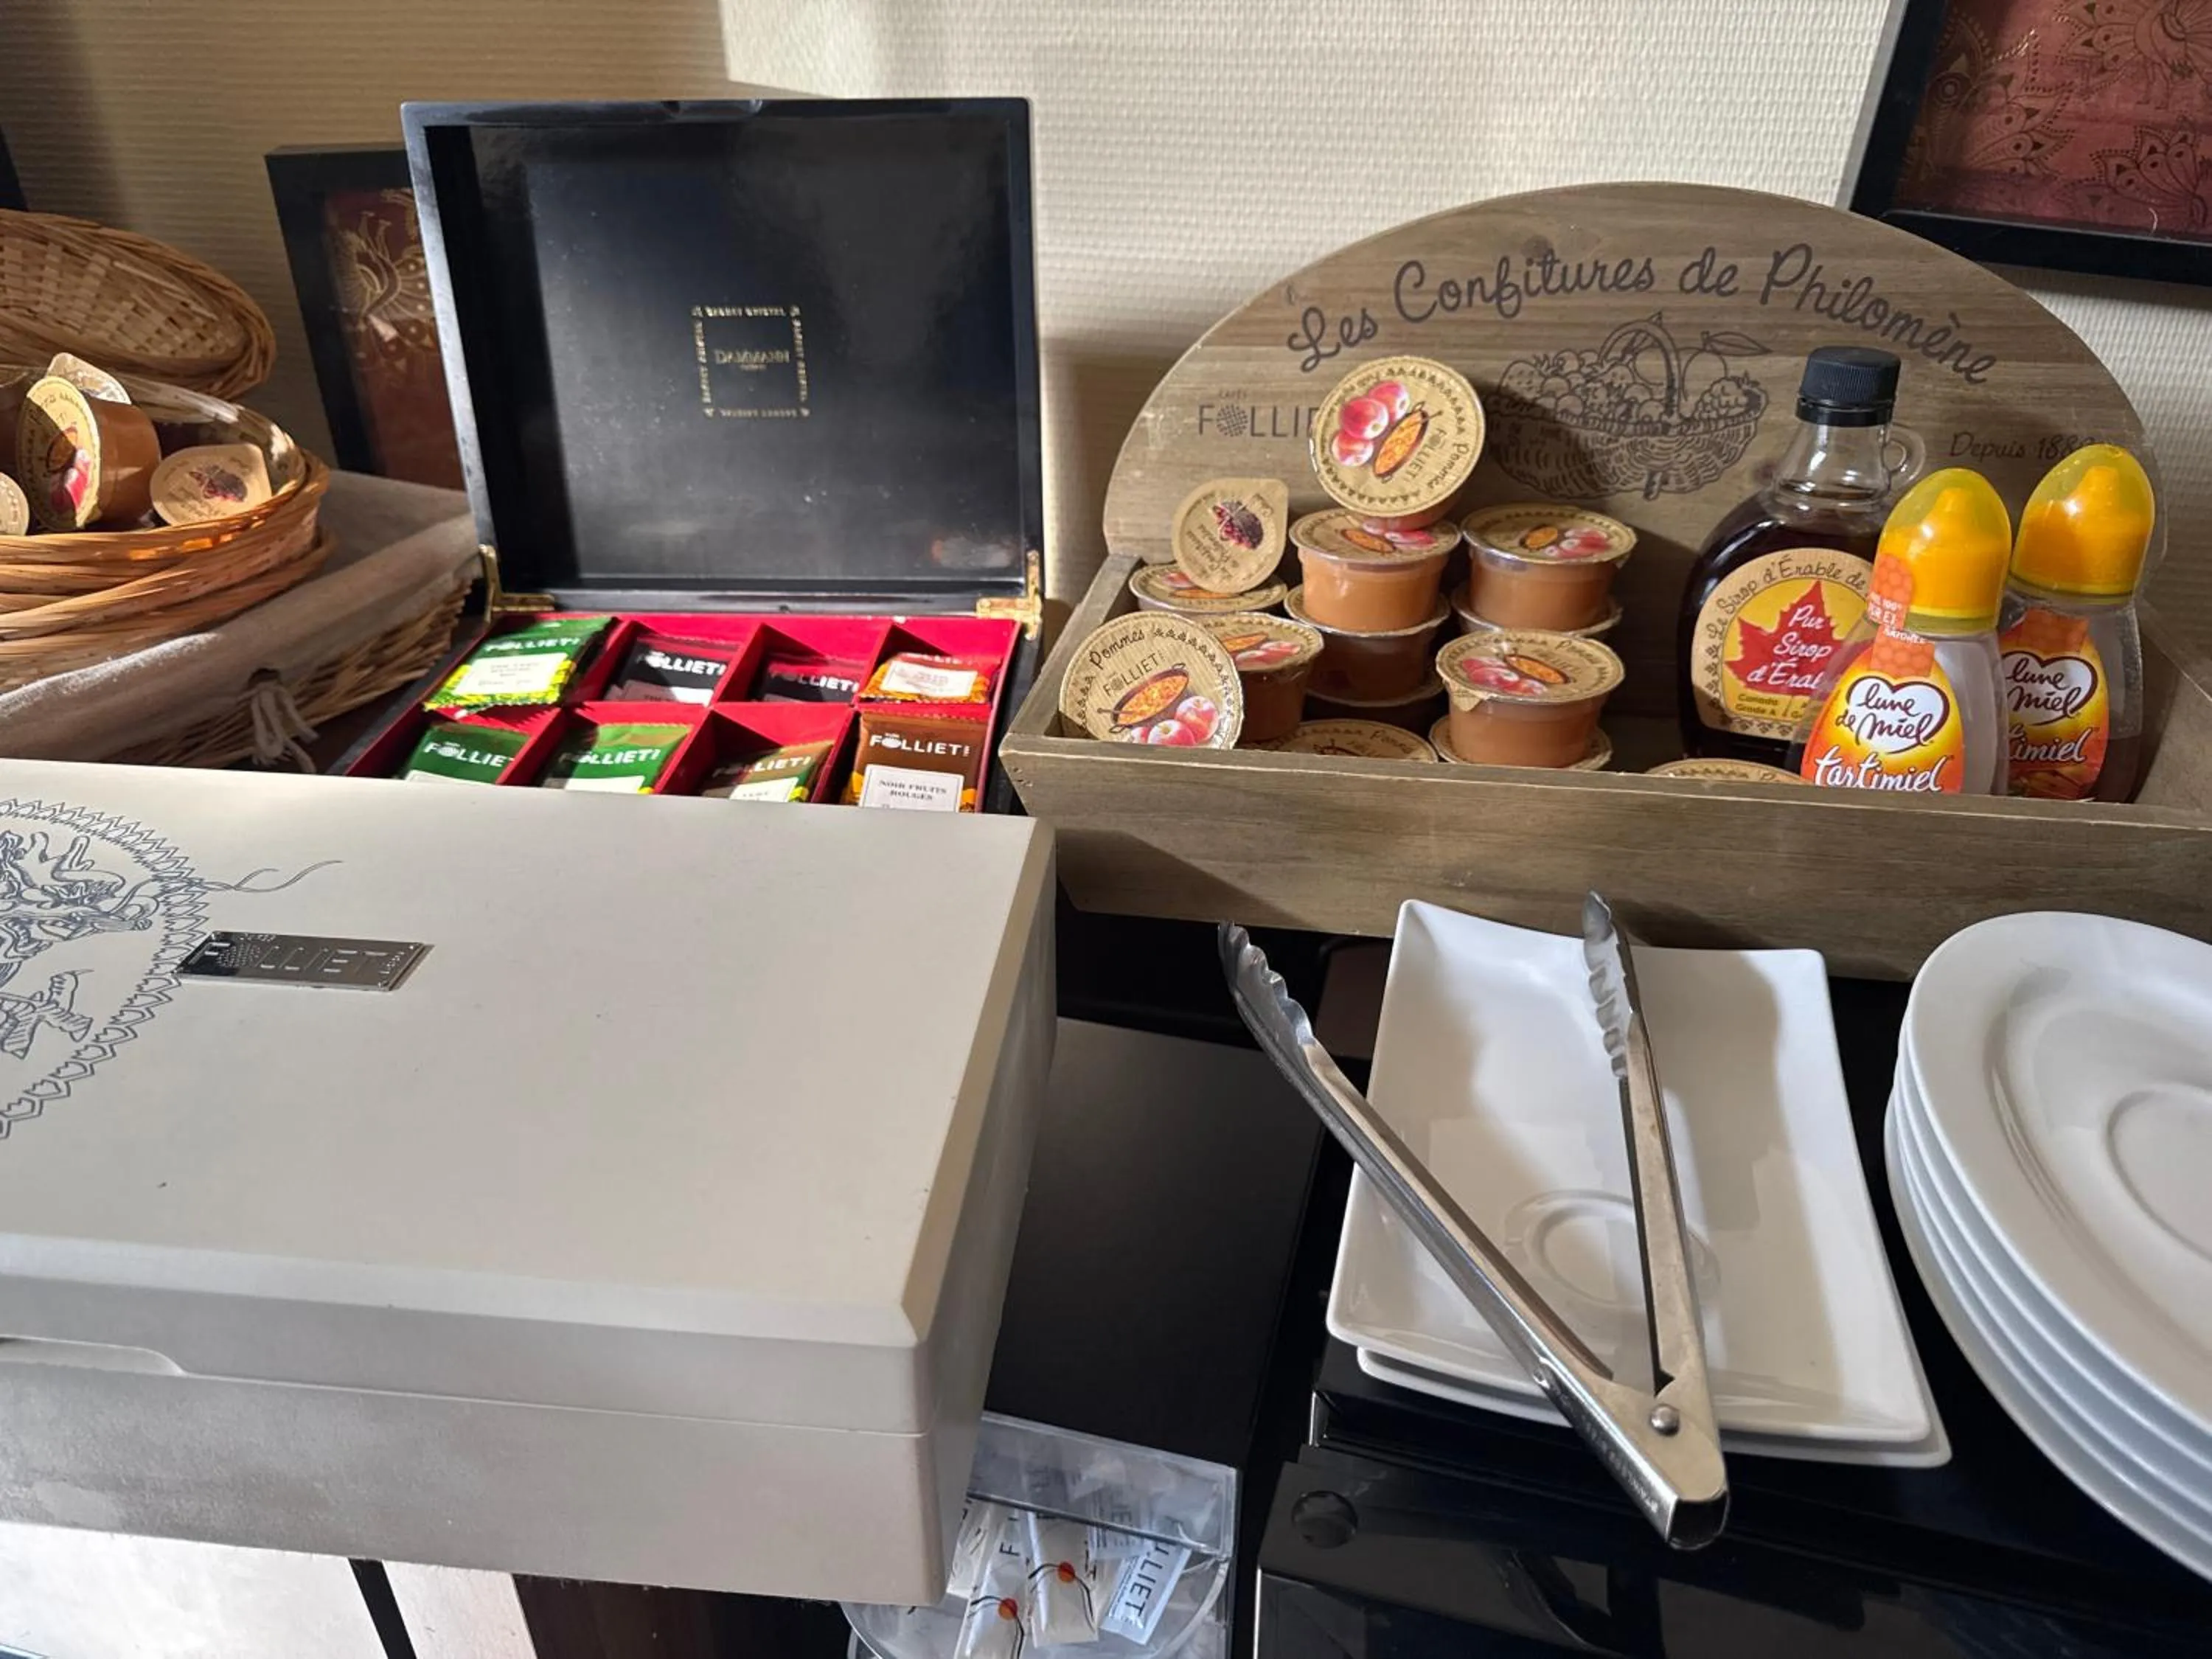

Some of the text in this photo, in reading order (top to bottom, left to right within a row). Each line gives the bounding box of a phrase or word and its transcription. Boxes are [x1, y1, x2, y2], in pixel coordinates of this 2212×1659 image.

[1287, 243, 1997, 386] Les Confitures de Philomène
[1199, 405, 1320, 437] FOLLIE
[1950, 431, 2025, 462] Depuis
[1716, 580, 1758, 614] Sirop
[1763, 555, 1841, 582] d'Érable
[1846, 571, 1867, 590] de
[1788, 605, 1826, 630] Pur
[1090, 630, 1146, 668] Pommes
[1773, 632, 1832, 662] Sirop
[1103, 653, 1160, 697] FOLLIET
[2005, 657, 2066, 690] lune
[1857, 683, 1920, 717] lune
[1835, 709, 1857, 731] de
[869, 734, 963, 756] FOLLIET
[1814, 745, 1947, 792] tartimiel
[1125, 1542, 1170, 1617] LLIET
